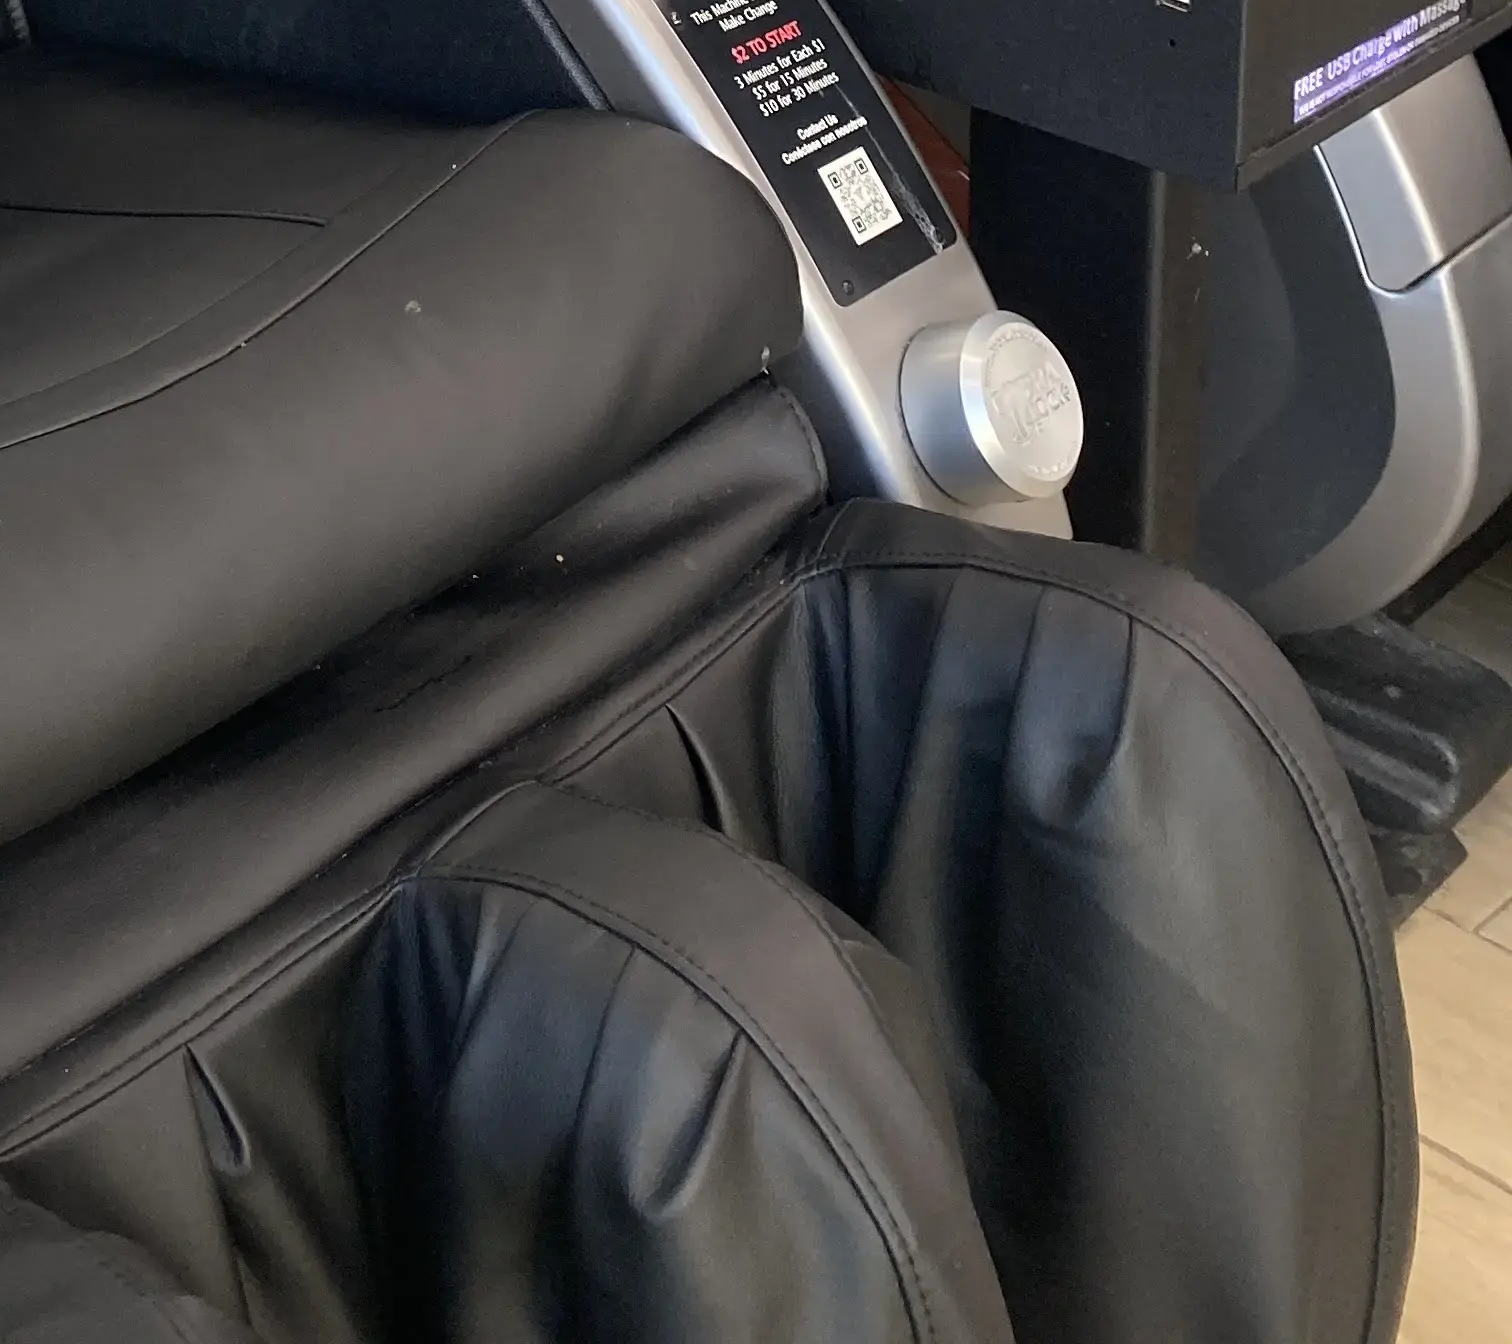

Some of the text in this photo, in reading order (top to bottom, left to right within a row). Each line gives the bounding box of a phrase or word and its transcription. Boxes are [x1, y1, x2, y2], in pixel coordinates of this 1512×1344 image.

[690, 9, 713, 25] This
[718, 0, 778, 32] Make Change
[731, 20, 802, 64] $2 TO START
[734, 38, 826, 89] 3 Minutes for Each $1
[1294, 67, 1324, 100] FREE
[1327, 52, 1350, 80] USB
[1352, 30, 1391, 65] Charge
[1393, 15, 1418, 43] with
[752, 58, 828, 100] $5 for 15 Minutes
[759, 72, 840, 117] $10 for 30 Minutes
[797, 118, 829, 140] Contact
